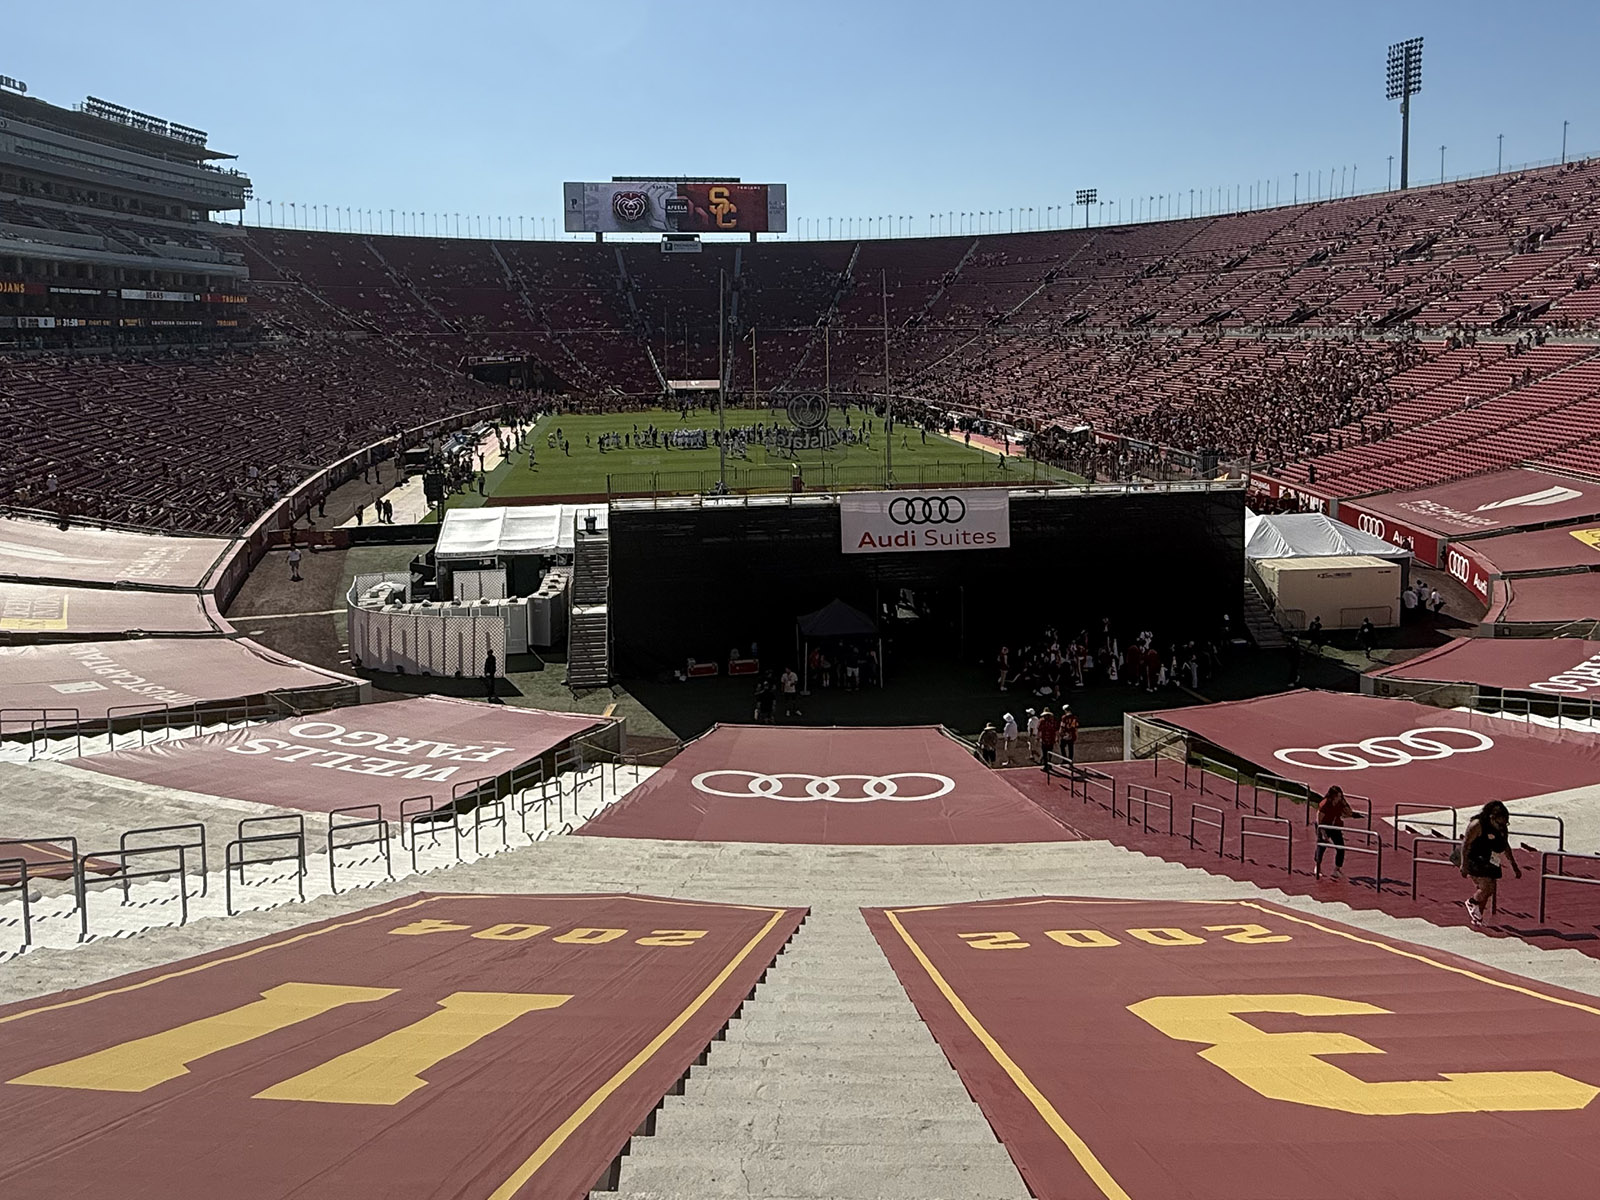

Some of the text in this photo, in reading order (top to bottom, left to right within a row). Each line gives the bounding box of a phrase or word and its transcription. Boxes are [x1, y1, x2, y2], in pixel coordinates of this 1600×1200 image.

[858, 529, 997, 548] Audi Suites
[1473, 573, 1488, 596] Audi
[289, 722, 516, 763] FARGO
[227, 739, 460, 782] WELLS
[387, 918, 709, 946] 2004
[957, 923, 1293, 950] 2002
[1126, 993, 1600, 1116] 3
